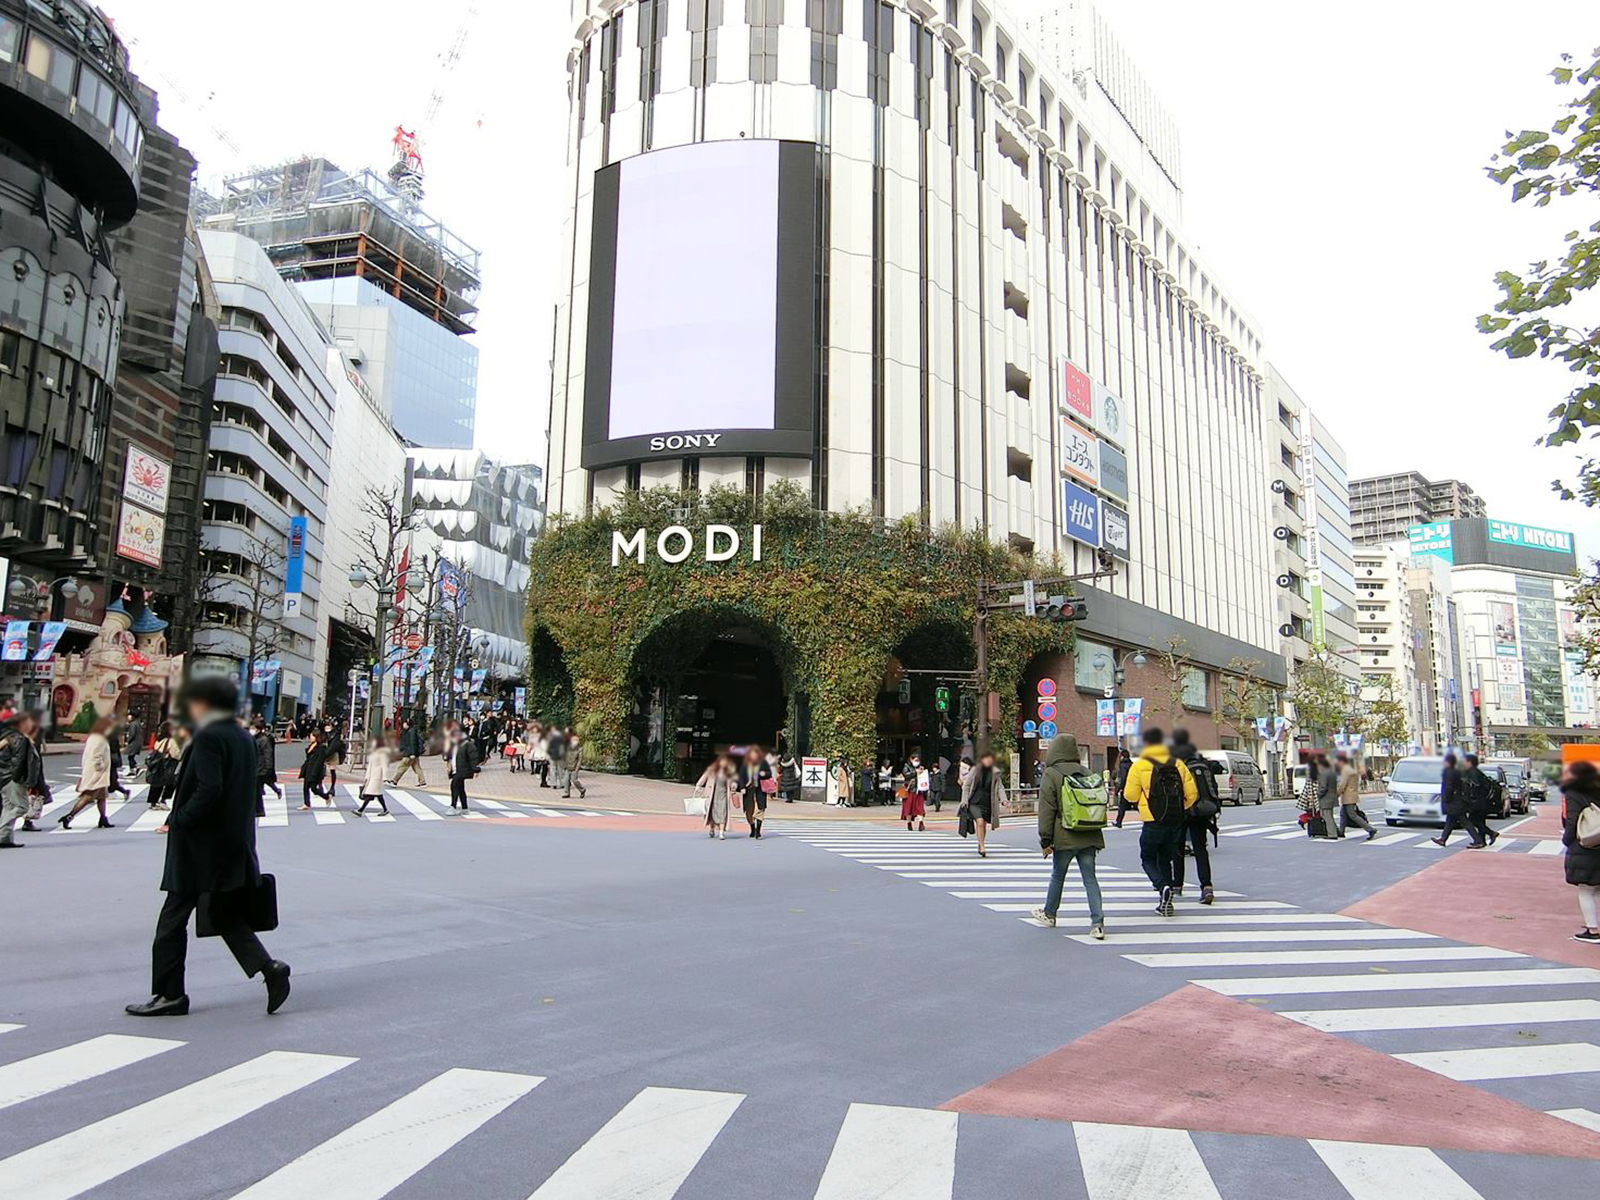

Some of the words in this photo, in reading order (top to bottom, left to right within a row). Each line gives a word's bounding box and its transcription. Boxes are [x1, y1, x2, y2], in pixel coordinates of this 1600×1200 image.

[650, 434, 722, 451] SONY
[1072, 434, 1089, 456] エース
[1066, 445, 1096, 473] コンタクト
[1410, 524, 1451, 542] ニトリ
[1491, 521, 1519, 542] ニトリ
[1522, 527, 1571, 550] NITORI
[611, 524, 762, 567] MODI
[1410, 540, 1451, 552] NITORI
[287, 599, 297, 611] P
[471, 659, 480, 669] 6
[1104, 685, 1114, 698] 5
[806, 766, 823, 785] 本
